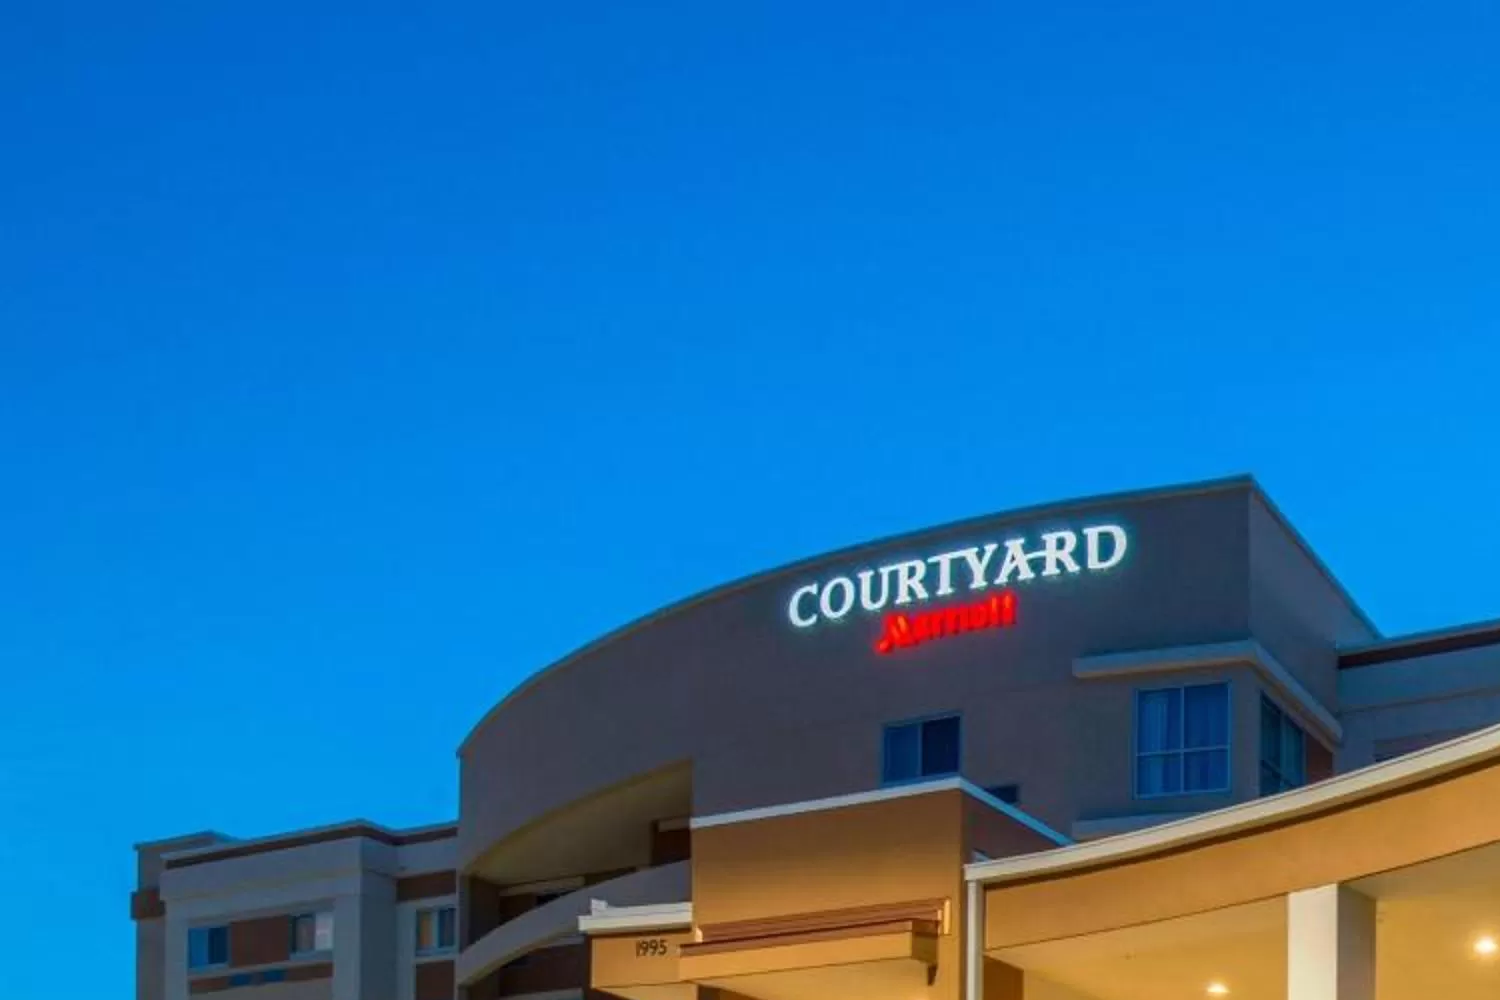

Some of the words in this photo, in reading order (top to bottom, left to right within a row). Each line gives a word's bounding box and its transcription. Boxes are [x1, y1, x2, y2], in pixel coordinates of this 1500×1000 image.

[788, 524, 1128, 628] COURTYARD
[875, 590, 1017, 653] Marriott
[636, 939, 668, 957] 1995
